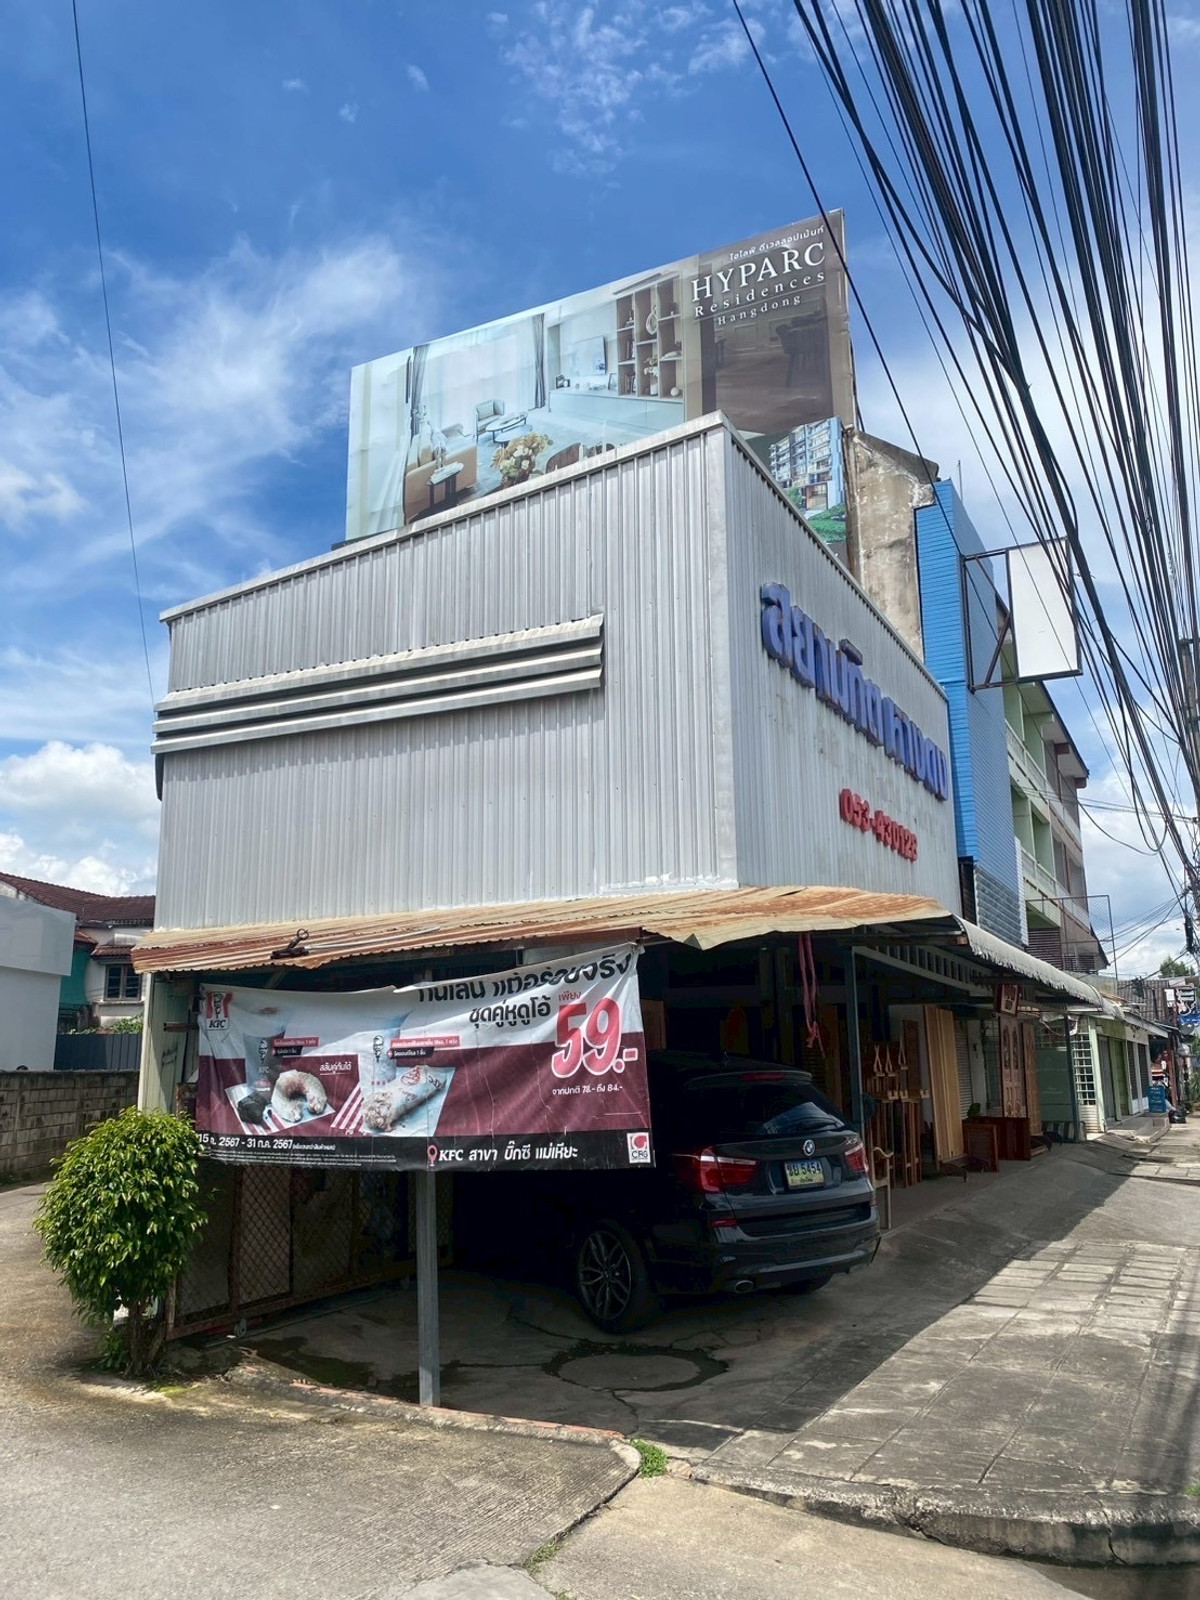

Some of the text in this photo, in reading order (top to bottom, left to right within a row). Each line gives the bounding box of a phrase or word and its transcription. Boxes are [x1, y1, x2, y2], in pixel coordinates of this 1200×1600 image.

[691, 242, 825, 302] HYPARC
[695, 272, 825, 318] Residences
[717, 295, 800, 326] Hangdong
[209, 1020, 226, 1028] KFC
[469, 995, 551, 1029] ชุดคู่หูดูโอ้
[552, 997, 638, 1078] 59.-
[218, 1136, 240, 1147] 2567
[247, 1138, 256, 1148] 31
[272, 1139, 293, 1149] 2567
[438, 1149, 463, 1162] KFC
[468, 1149, 498, 1161] สาขา
[504, 1140, 531, 1161] บิ๊กซี
[631, 1150, 648, 1159] CRG
